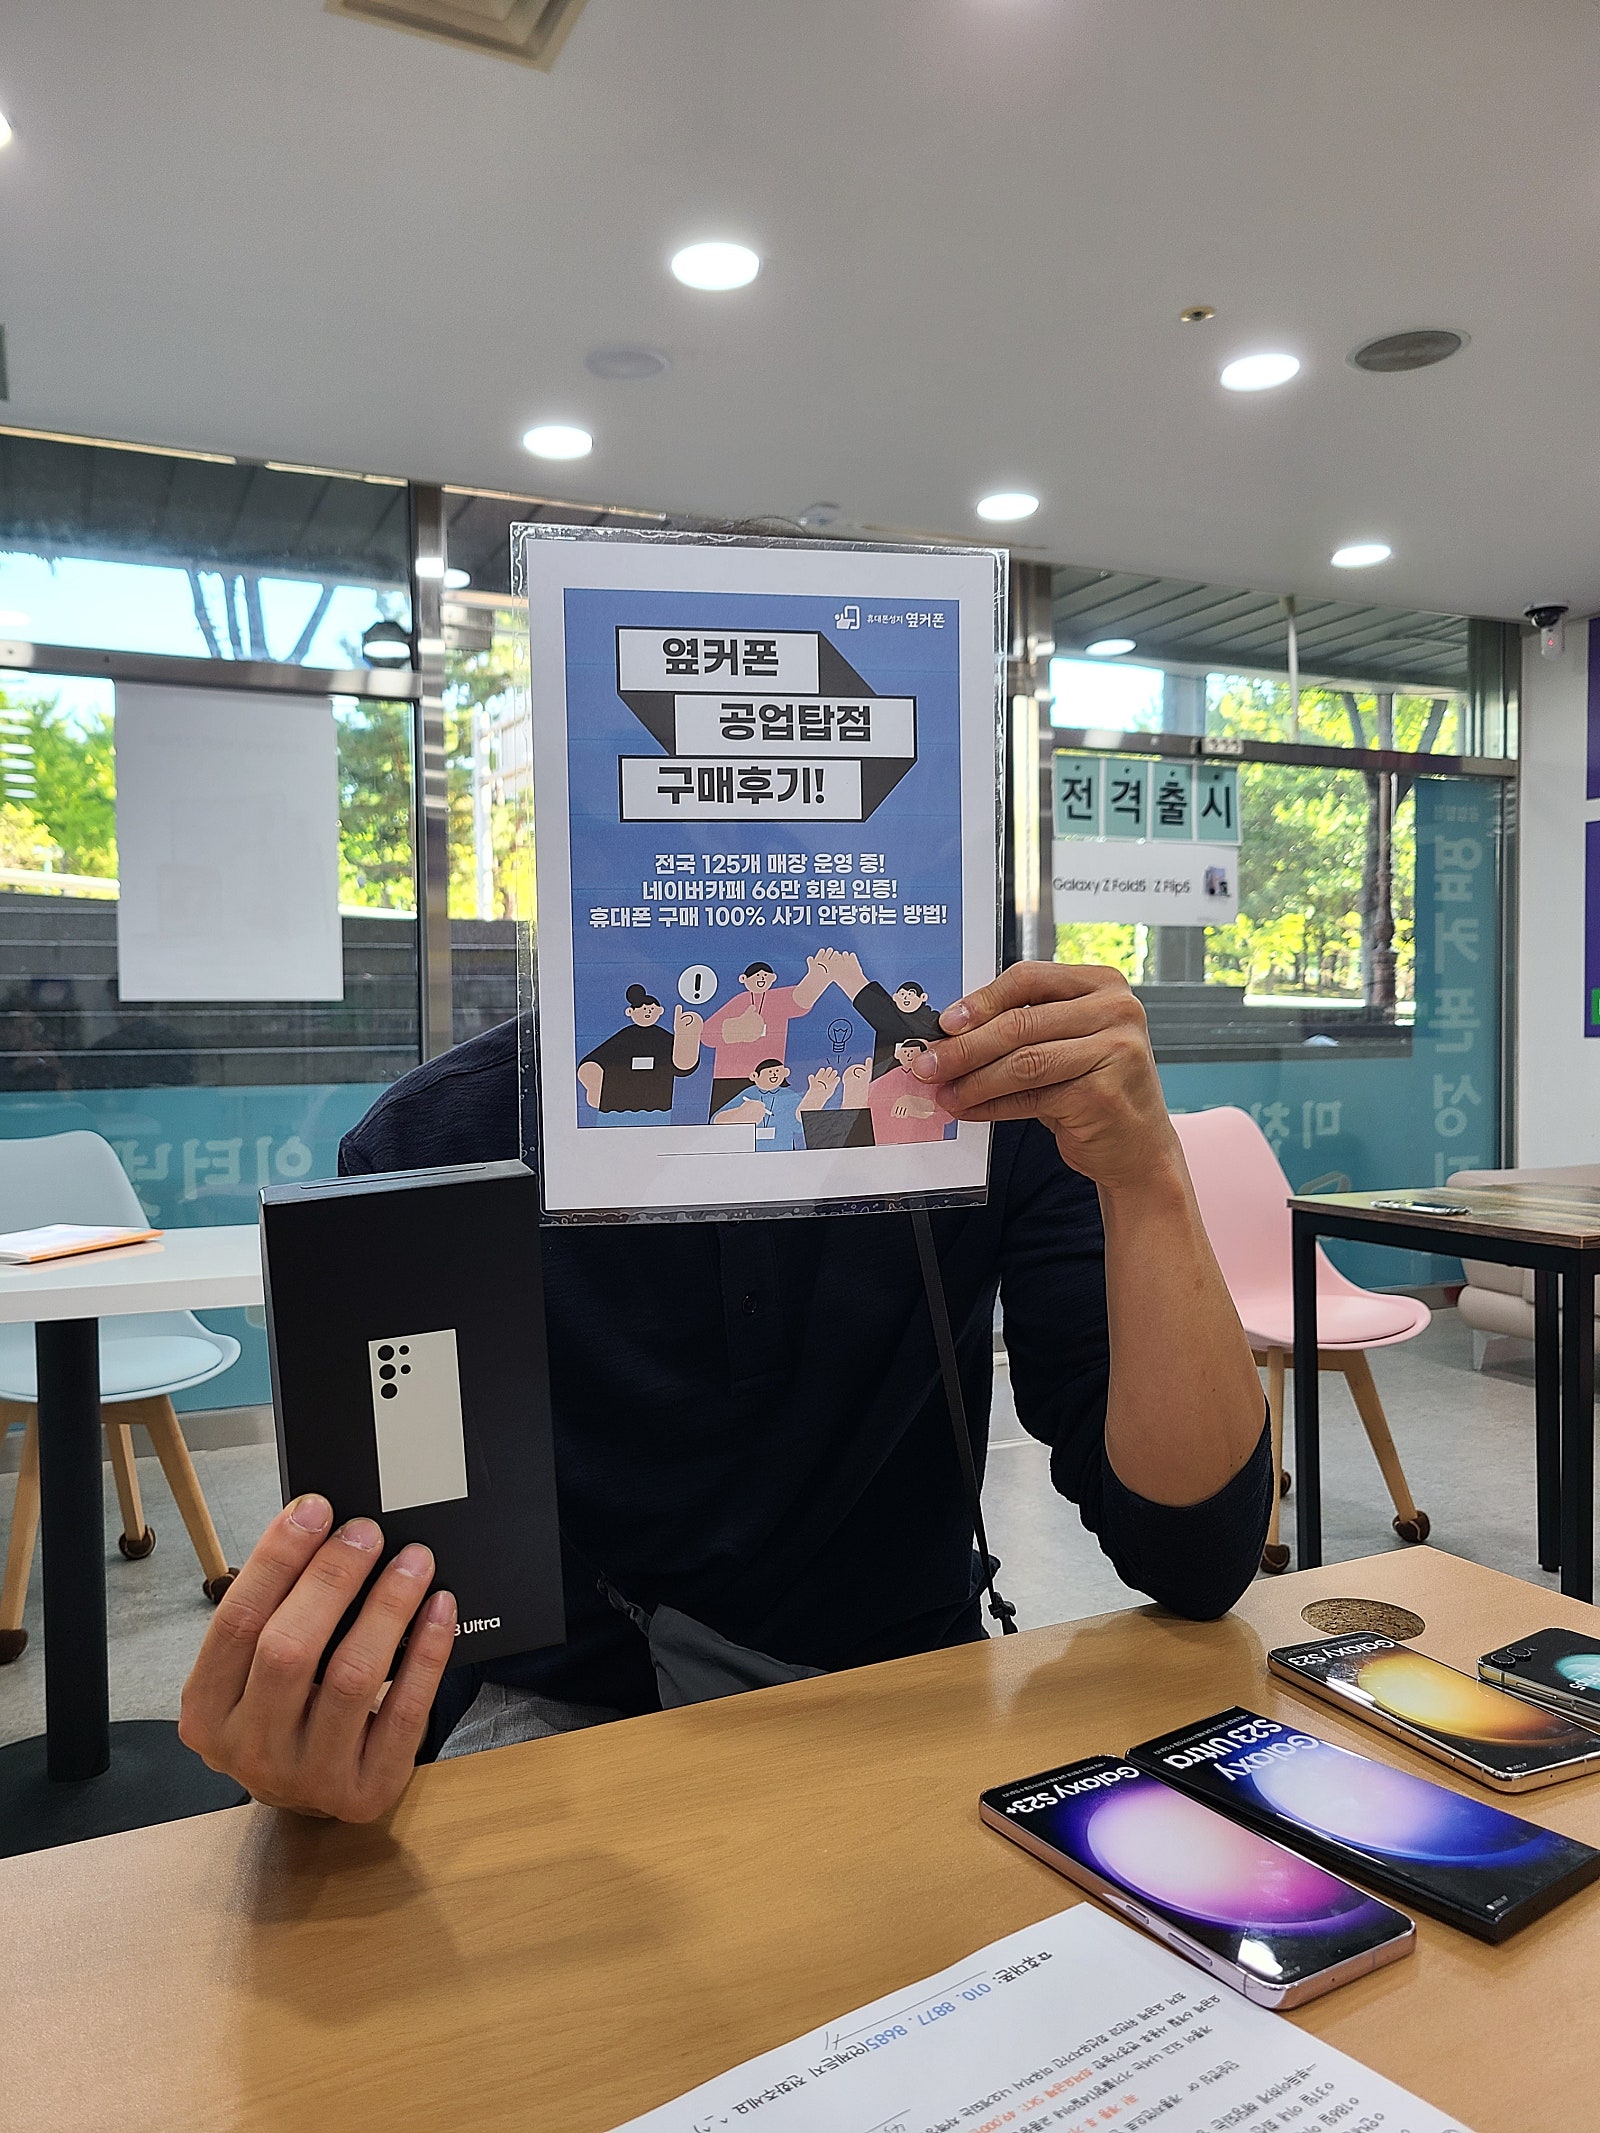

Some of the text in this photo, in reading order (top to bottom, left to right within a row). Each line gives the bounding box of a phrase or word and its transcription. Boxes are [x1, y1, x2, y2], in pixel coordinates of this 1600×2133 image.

[866, 612, 946, 629] 휴대폰성지 옆커폰
[662, 637, 779, 677] 옆커폰
[719, 702, 872, 742] 공업탑점
[657, 765, 825, 805] 구매후기!
[1061, 777, 1231, 829] 전격출시
[654, 853, 886, 875] 전국 125개 매장 운영 중!
[641, 879, 898, 901] 네이버카페 66만 회원 인증!
[1053, 878, 1100, 895] Galaxy
[1112, 879, 1147, 893] Fold5
[1163, 880, 1191, 896] Flip5
[589, 903, 949, 928] 휴대폰 구매 100% 사기 안당하는 방법!
[463, 1616, 501, 1635] Ultra
[1287, 1652, 1328, 1667] S23
[1325, 1638, 1396, 1661] Galaxy
[1227, 1718, 1283, 1743] S23
[1162, 1737, 1243, 1770] Ultra
[1213, 1734, 1321, 1782] Galaxy
[1057, 1765, 1141, 1800] Galaxy
[1005, 1791, 1060, 1815] S23+
[731, 2073, 808, 2115] 전화주세요
